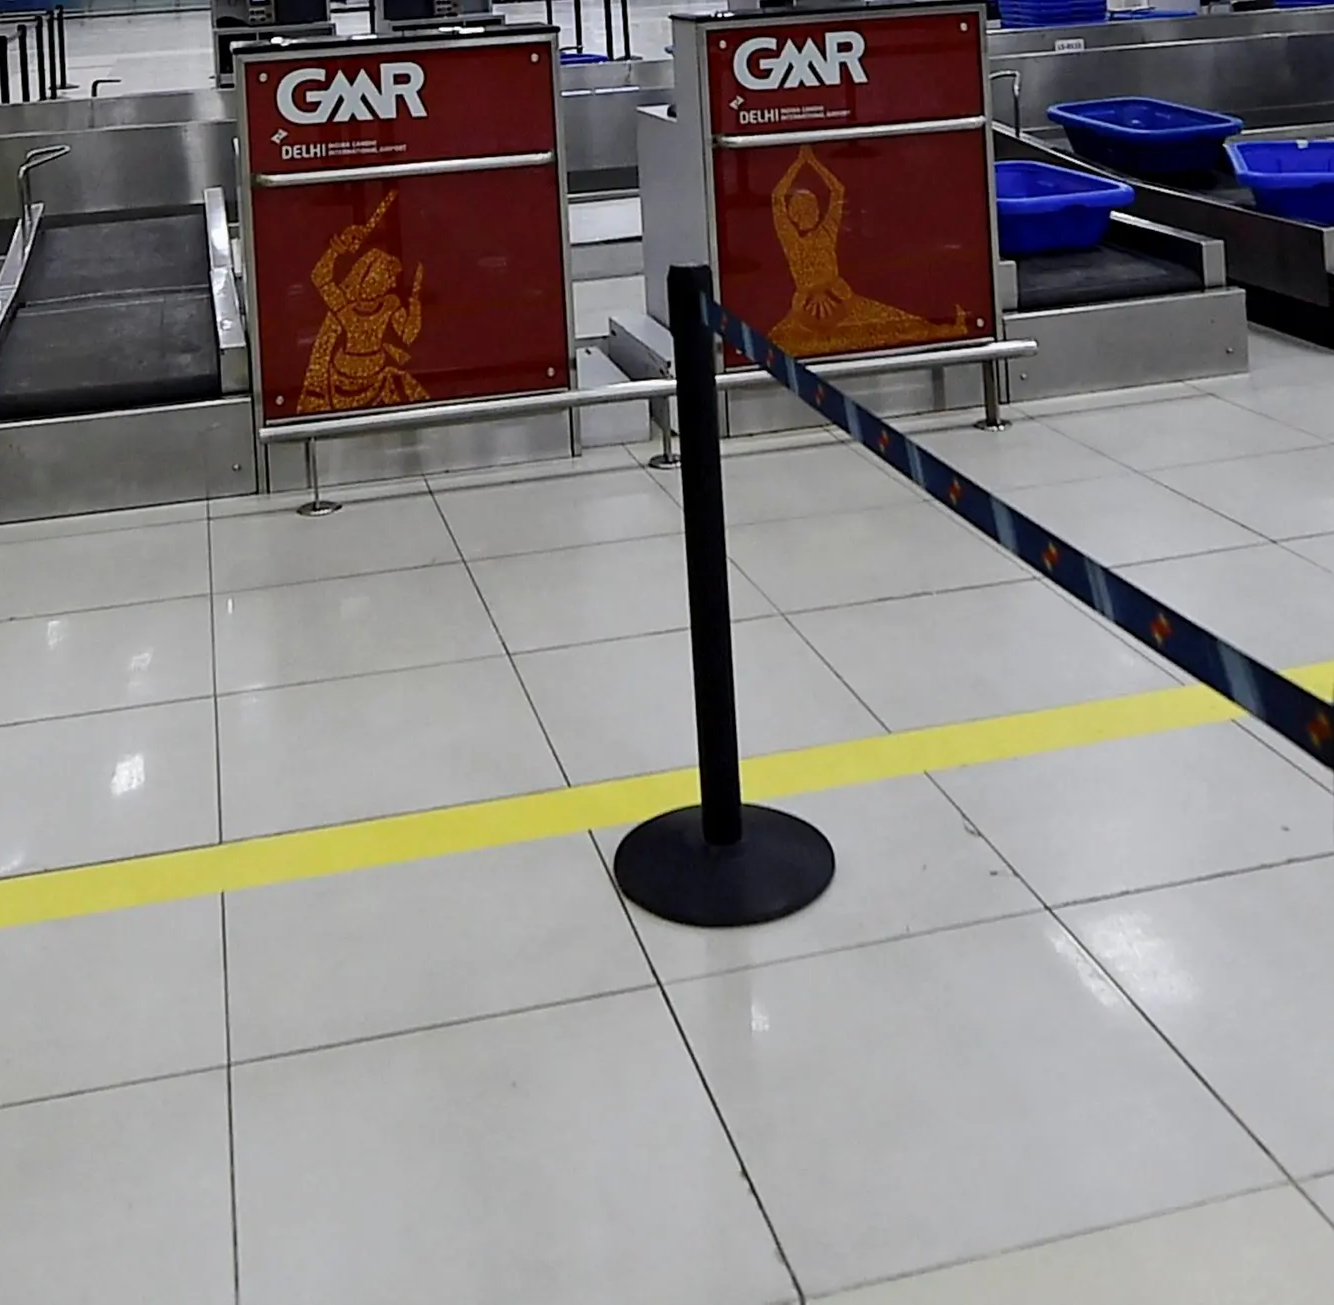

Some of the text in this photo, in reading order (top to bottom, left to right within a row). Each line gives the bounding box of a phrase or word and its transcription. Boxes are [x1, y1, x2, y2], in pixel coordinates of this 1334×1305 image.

[733, 30, 869, 90] GMR
[276, 62, 427, 124] GMR
[739, 108, 779, 124] DELHI
[282, 143, 326, 160] DELHI
